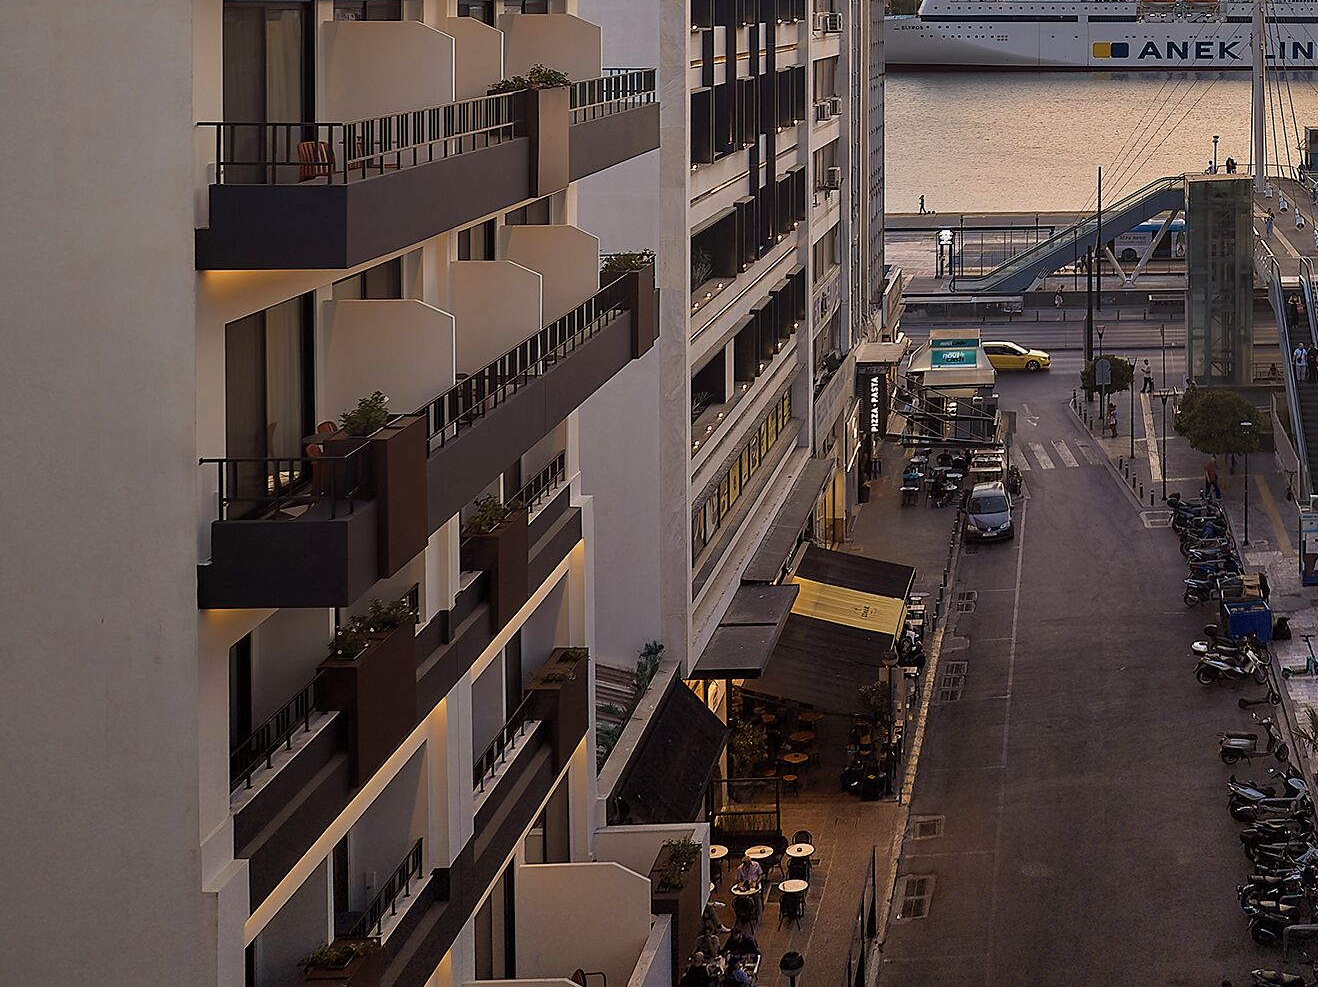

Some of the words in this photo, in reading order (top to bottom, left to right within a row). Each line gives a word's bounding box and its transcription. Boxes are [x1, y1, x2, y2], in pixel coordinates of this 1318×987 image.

[1138, 41, 1243, 60] ANEK
[870, 376, 879, 404] PASTA
[870, 407, 879, 433] PIZZA
